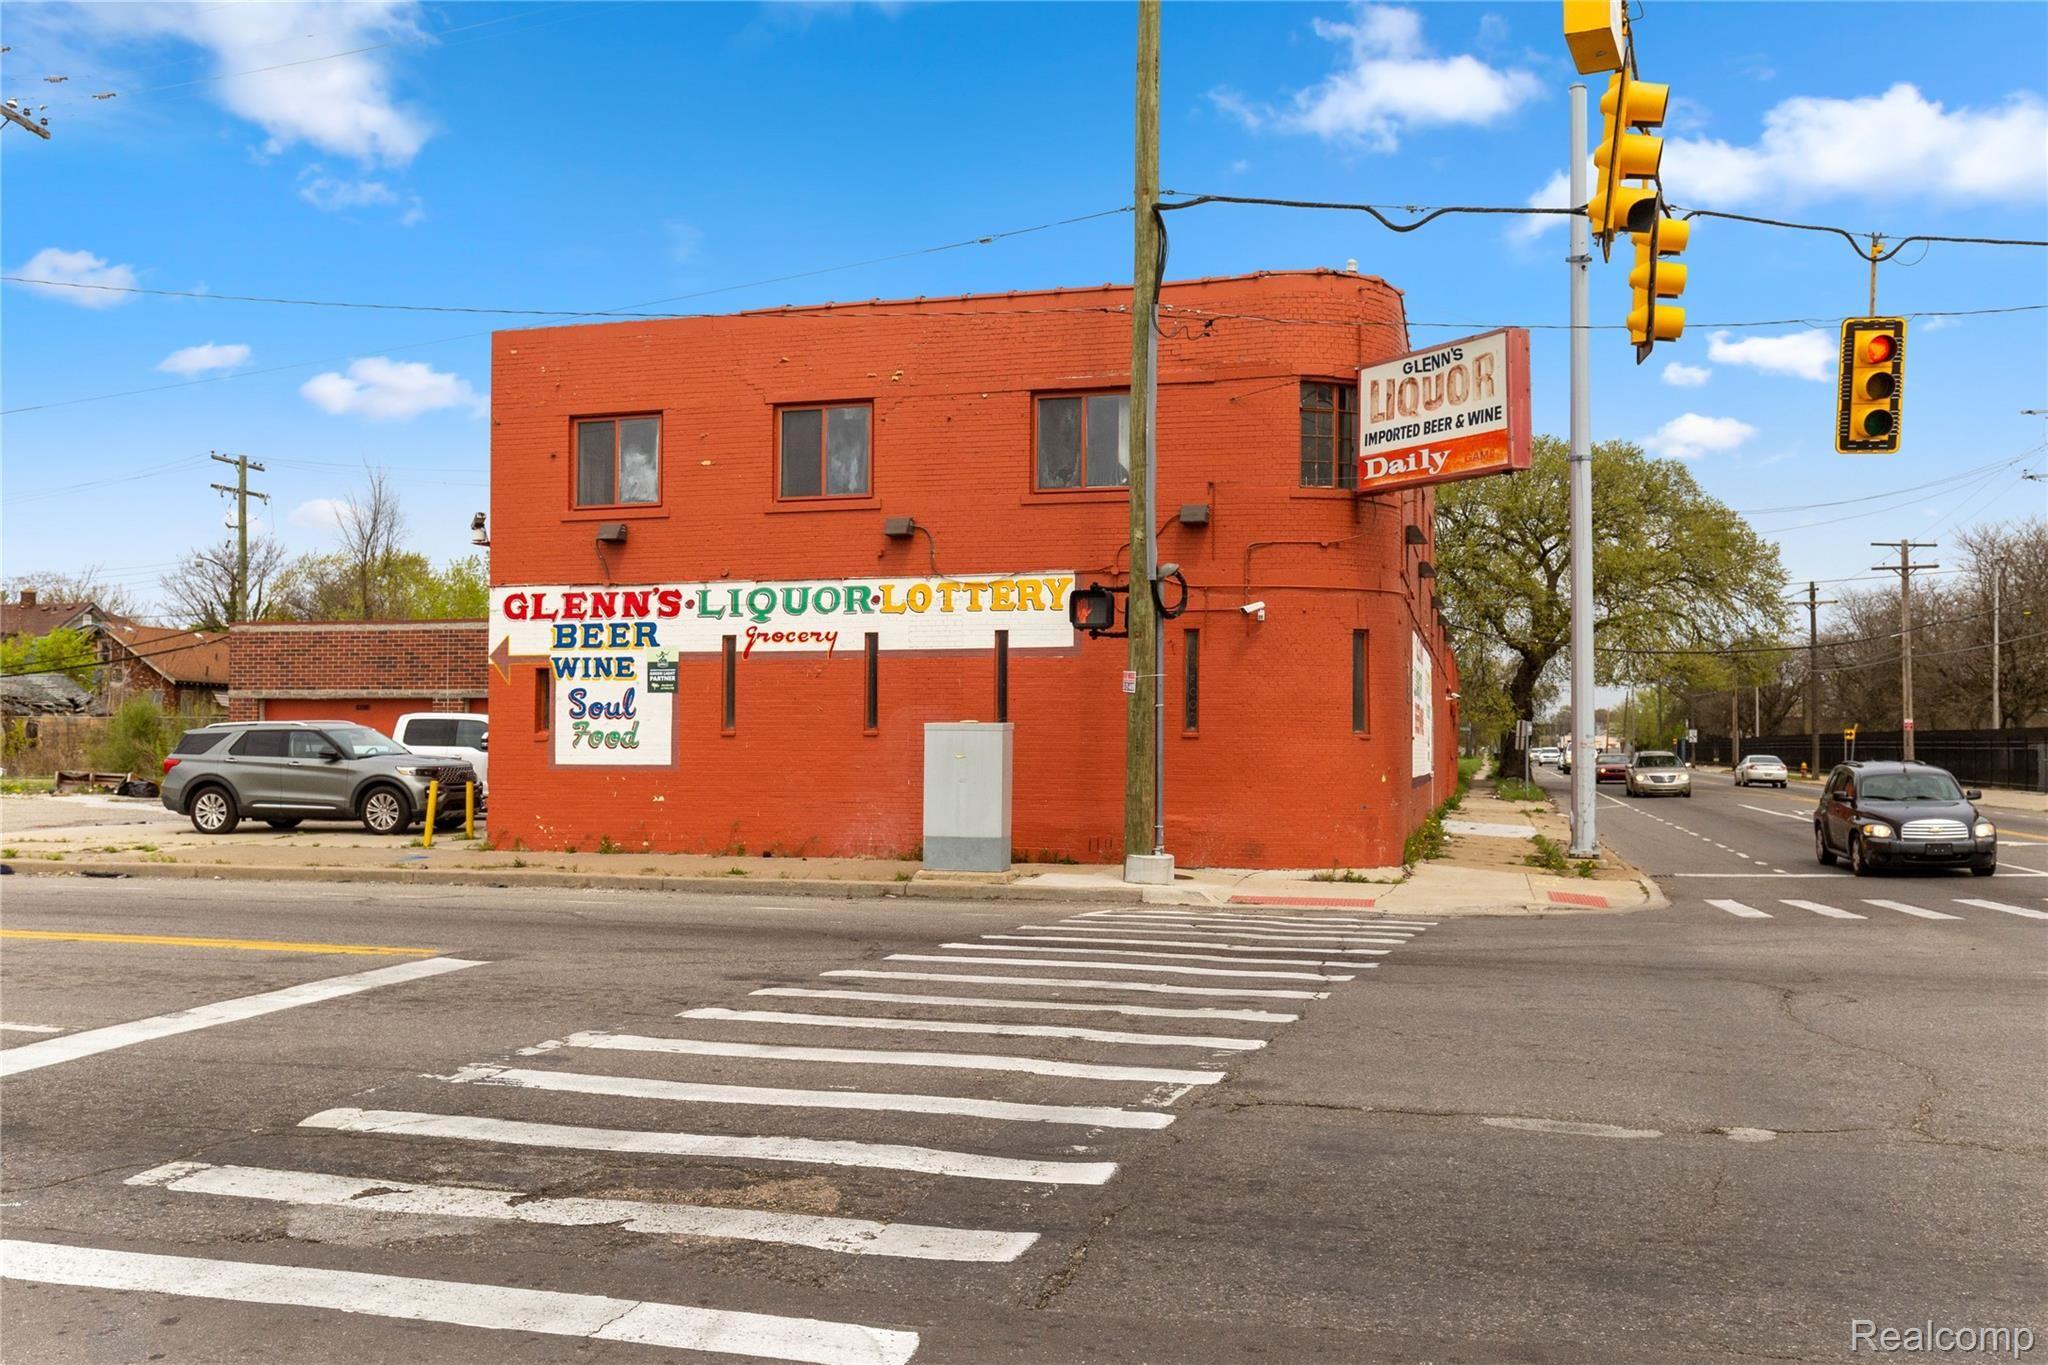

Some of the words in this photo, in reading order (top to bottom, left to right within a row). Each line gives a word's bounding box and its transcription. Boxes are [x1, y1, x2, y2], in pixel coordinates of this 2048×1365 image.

[1402, 348, 1464, 375] GLENN'S
[1370, 352, 1496, 424] LIQUOR
[1364, 423, 1421, 447] IMPORTED
[1423, 416, 1453, 436] BEER
[1455, 413, 1465, 429] &
[1467, 405, 1503, 427] WINE
[1363, 448, 1452, 480] Daily
[503, 587, 683, 622] GLENN'S
[696, 585, 873, 623] LIQUOR
[878, 577, 1074, 614] LOTTERY
[550, 621, 661, 650] BEER
[551, 656, 638, 681] WINE
[568, 687, 637, 720] Soul
[571, 720, 640, 750] Food
